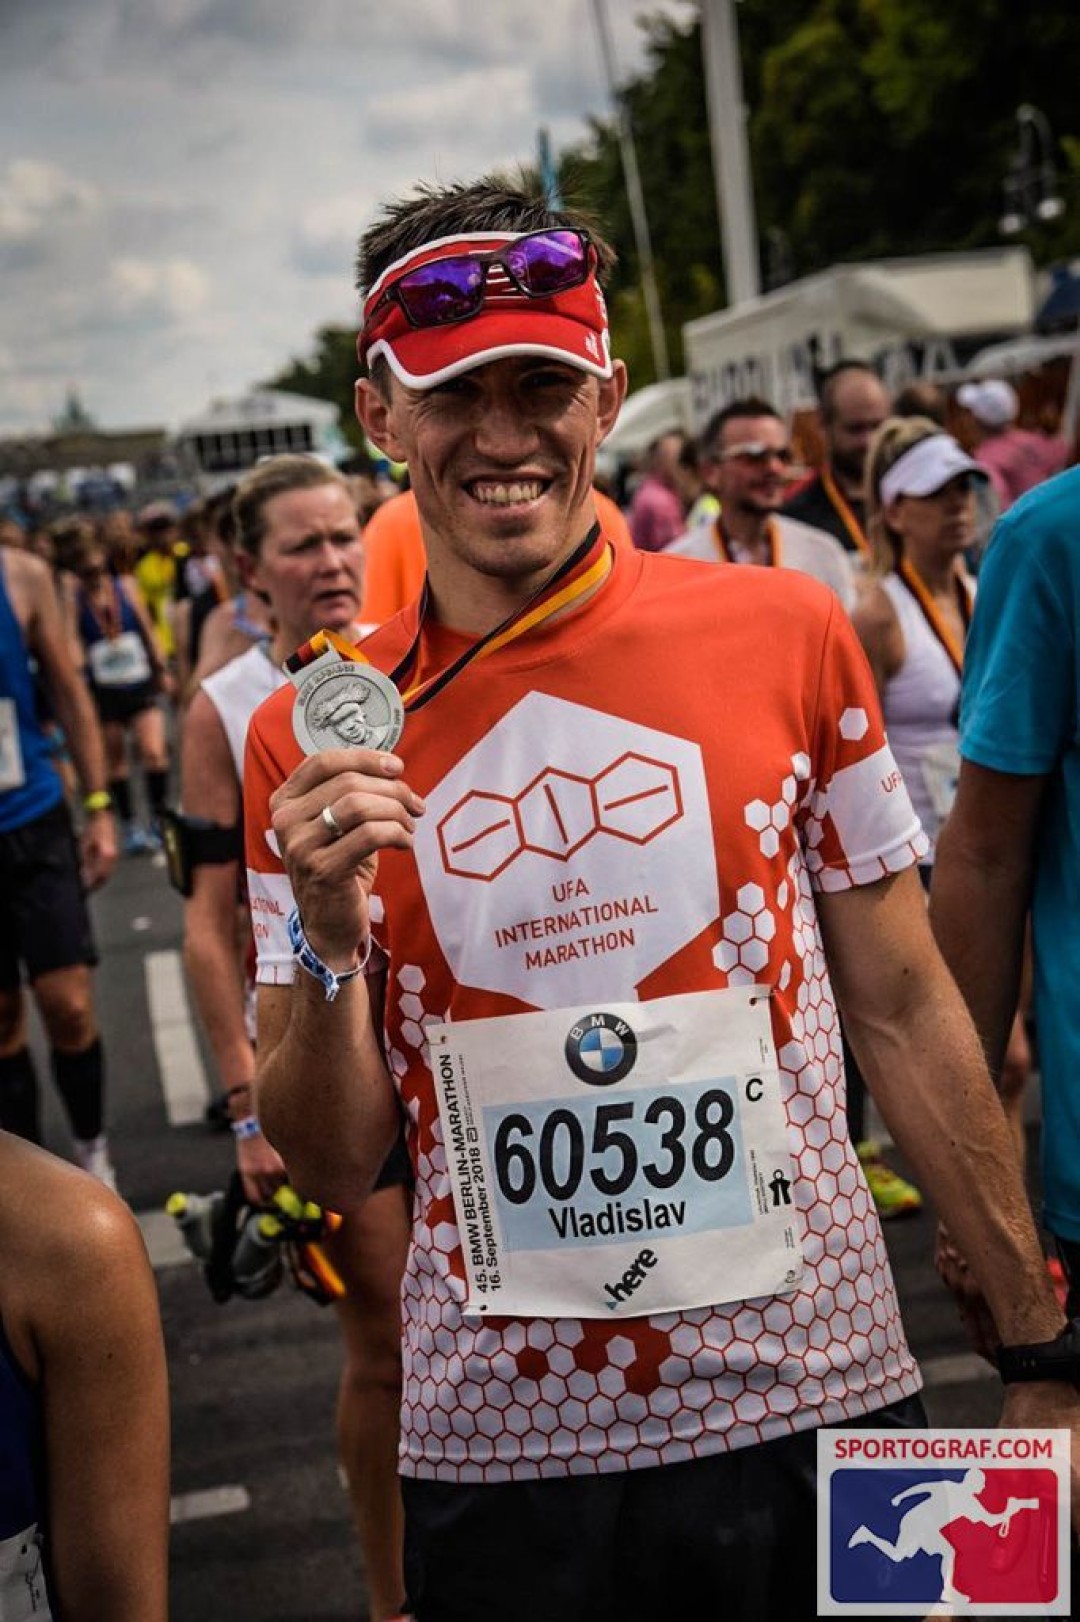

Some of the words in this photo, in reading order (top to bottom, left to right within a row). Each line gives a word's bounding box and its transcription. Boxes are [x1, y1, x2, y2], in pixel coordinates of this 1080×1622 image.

[552, 878, 589, 902] UFA
[495, 895, 658, 948] INTERNATIONAL
[525, 928, 635, 970] MARATHON
[570, 1014, 630, 1040] BMW
[745, 1077, 764, 1102] C
[439, 1054, 477, 1221] BERLIN-MARATHON
[494, 1088, 735, 1205] 60538
[468, 1147, 486, 1184] 2018
[478, 1187, 498, 1268] September
[549, 1198, 687, 1239] Vladislav
[466, 1222, 484, 1267] BMW
[475, 1268, 488, 1293] 45.
[489, 1269, 501, 1292] 16.
[604, 1248, 658, 1302] here
